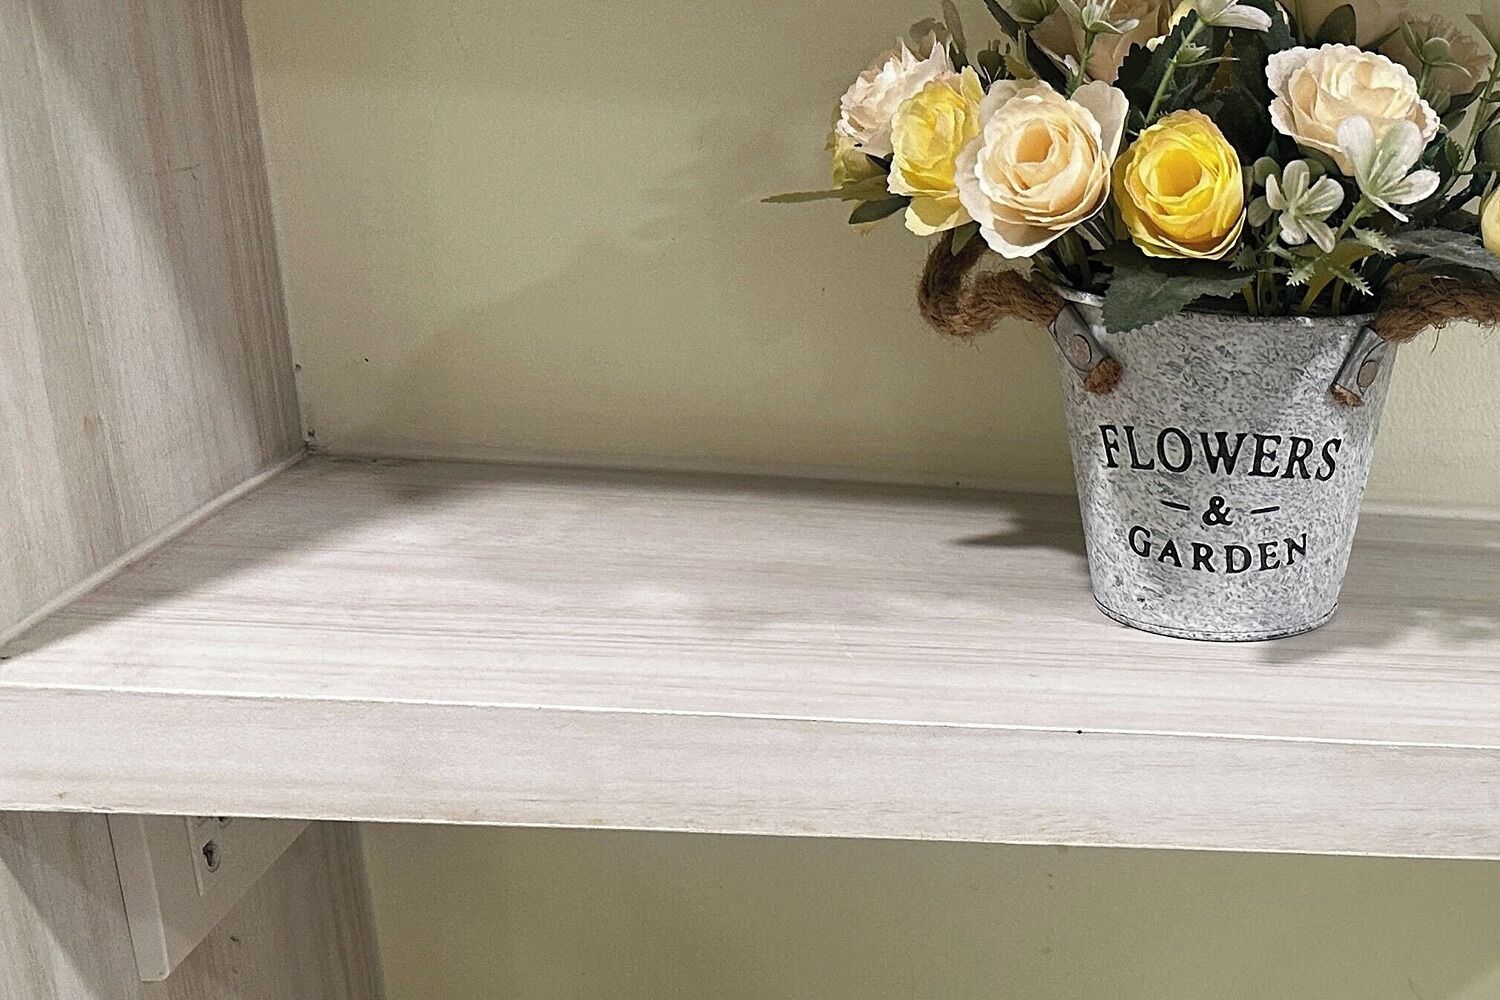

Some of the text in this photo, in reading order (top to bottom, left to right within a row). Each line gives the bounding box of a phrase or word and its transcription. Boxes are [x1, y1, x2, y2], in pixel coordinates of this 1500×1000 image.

[1099, 424, 1342, 482] FLOWERS
[1201, 495, 1233, 526] &
[1128, 525, 1308, 574] GARDEN
